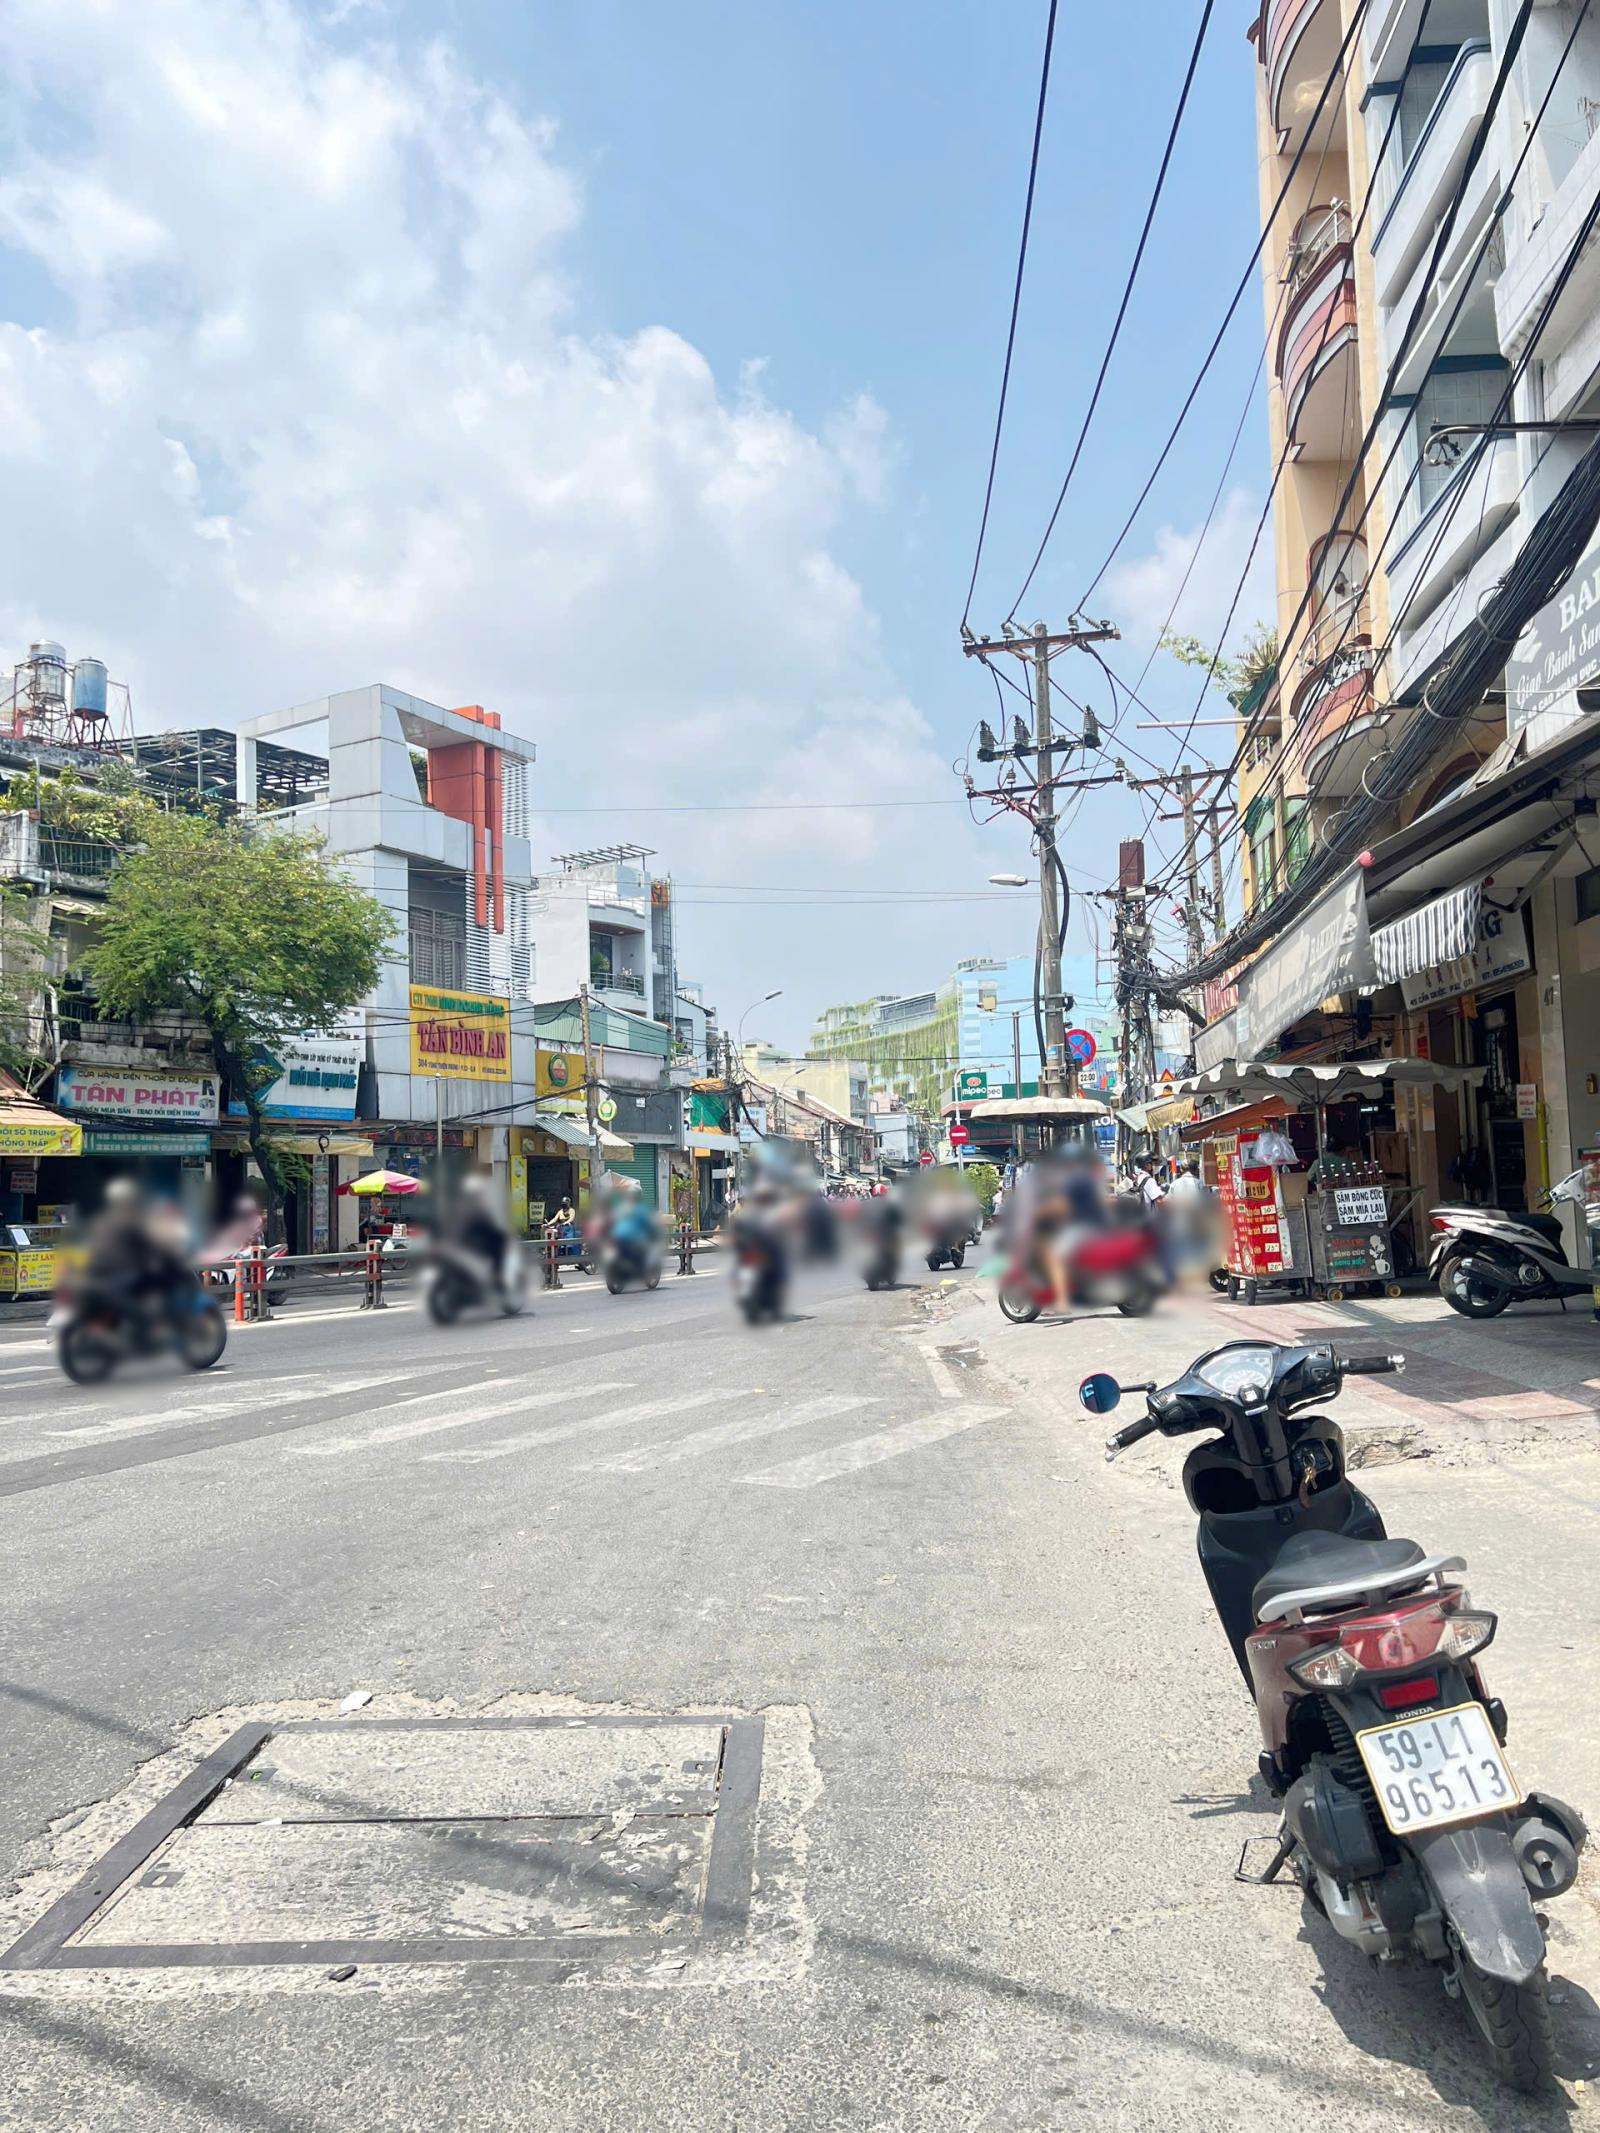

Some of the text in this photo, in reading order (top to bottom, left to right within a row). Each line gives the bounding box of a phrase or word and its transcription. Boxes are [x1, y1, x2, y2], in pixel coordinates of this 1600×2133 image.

[1544, 635, 1576, 682] Bánh
[486, 1032, 506, 1058] AN
[1080, 1072, 1096, 1082] 22:00
[134, 1087, 200, 1106] PHÁT
[962, 1087, 987, 1096] mipec
[1352, 1189, 1368, 1202] BÔNG
[1339, 1203, 1384, 1216] SÂM MÍA LAU
[1352, 1248, 1366, 1257] CÚC
[1395, 1706, 1434, 1720] HONDA
[1378, 1716, 1475, 1774] 59-L1
[1386, 1759, 1507, 1823] 965.13
